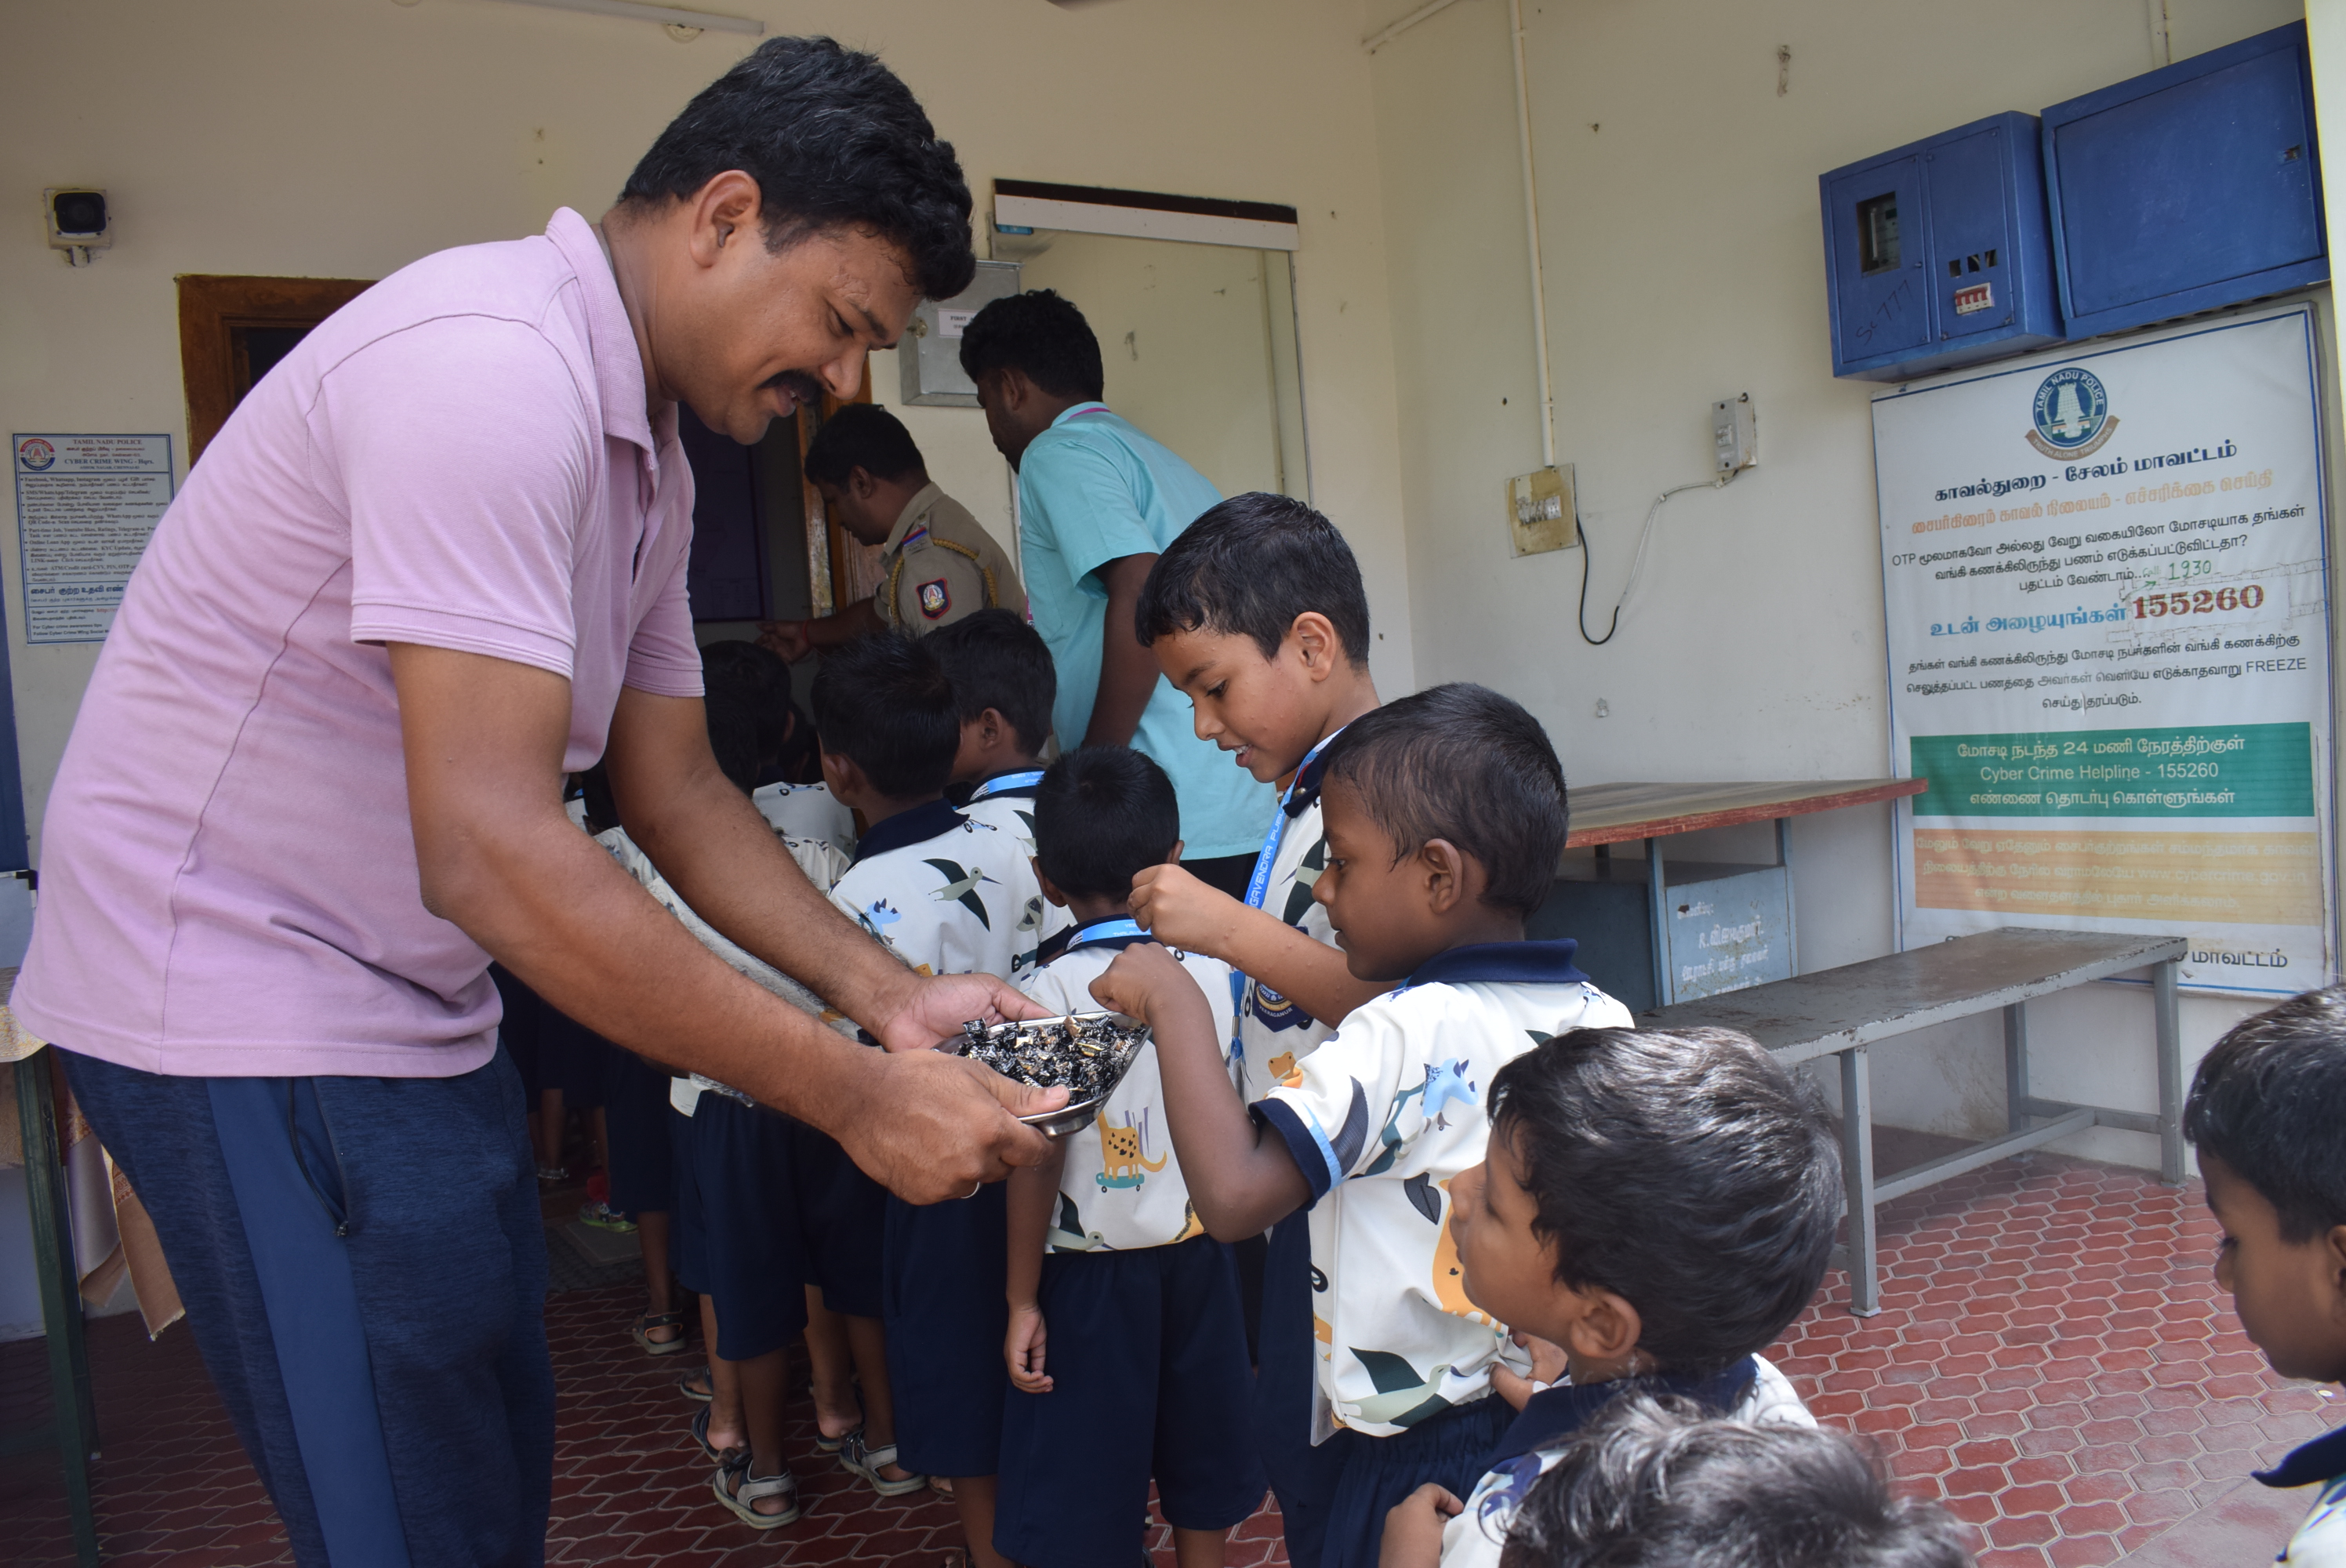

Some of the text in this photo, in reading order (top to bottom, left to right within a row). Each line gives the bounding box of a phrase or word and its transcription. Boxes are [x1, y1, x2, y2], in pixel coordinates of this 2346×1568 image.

[2036, 372, 2104, 412] TAMIL NADU POLICE
[2033, 426, 2113, 459] TRUTH ALONE TRIUMPHS
[1934, 474, 2046, 502] காவல்துறை
[2065, 456, 2128, 483] சேலம்
[2134, 439, 2238, 472] மாவட்டம்
[1912, 509, 1996, 534] சைபர்கிரைம்
[1999, 502, 2043, 523] காவல்
[2046, 492, 2112, 517] நிலையம்
[2125, 481, 2216, 506] எச்சரிக்கை
[2219, 468, 2274, 492] செய்தி
[1892, 503, 2306, 566] OTP மூலமாகவோ அல்லது வேறு வகையிலோ மோசடியாக தங்கள்
[1935, 565, 1967, 580] வங்கி
[1969, 555, 2061, 578] கணக்கிலிருந்து
[2065, 548, 2104, 567] பணம்
[2168, 560, 2212, 581] 1930
[82, 585, 104, 595] உதவி
[2019, 575, 2064, 594] பதட்டம்
[1930, 584, 2264, 637] உடன் அழையுங்கள் 155260
[1908, 659, 1945, 674] தங்கள்
[1948, 655, 1977, 669] வங்கி
[1980, 650, 2068, 666] கணக்கிலிருந்து
[2072, 648, 2115, 662] மோசடி
[2184, 637, 2221, 652] வங்கி
[2224, 633, 2301, 650] கணக்கிற்கு
[1980, 676, 2035, 691] பணத்தை
[2037, 671, 2092, 688] அவர்கள்
[2095, 667, 2150, 683] வெளியே
[2152, 664, 2242, 681] எடுக்காதவாறு
[2246, 657, 2307, 673] FREEZE
[2042, 695, 2083, 710] செய்து
[1957, 734, 2246, 761] மோசடி நடந்த 24 மணி நேரத்திற்குள்
[1981, 766, 2024, 784] Cyber
[2028, 765, 2075, 780] Crime
[2079, 764, 2141, 782] Helpline
[2157, 762, 2219, 779] 155260
[2046, 789, 2109, 809] தொடர்பு
[2113, 787, 2235, 808] கொள்ளுங்கள்
[1249, 845, 1273, 909] GAVENDRA
[2192, 948, 2289, 968] மாவட்டம்
[1258, 1004, 1293, 1018] VEERAGANUR
